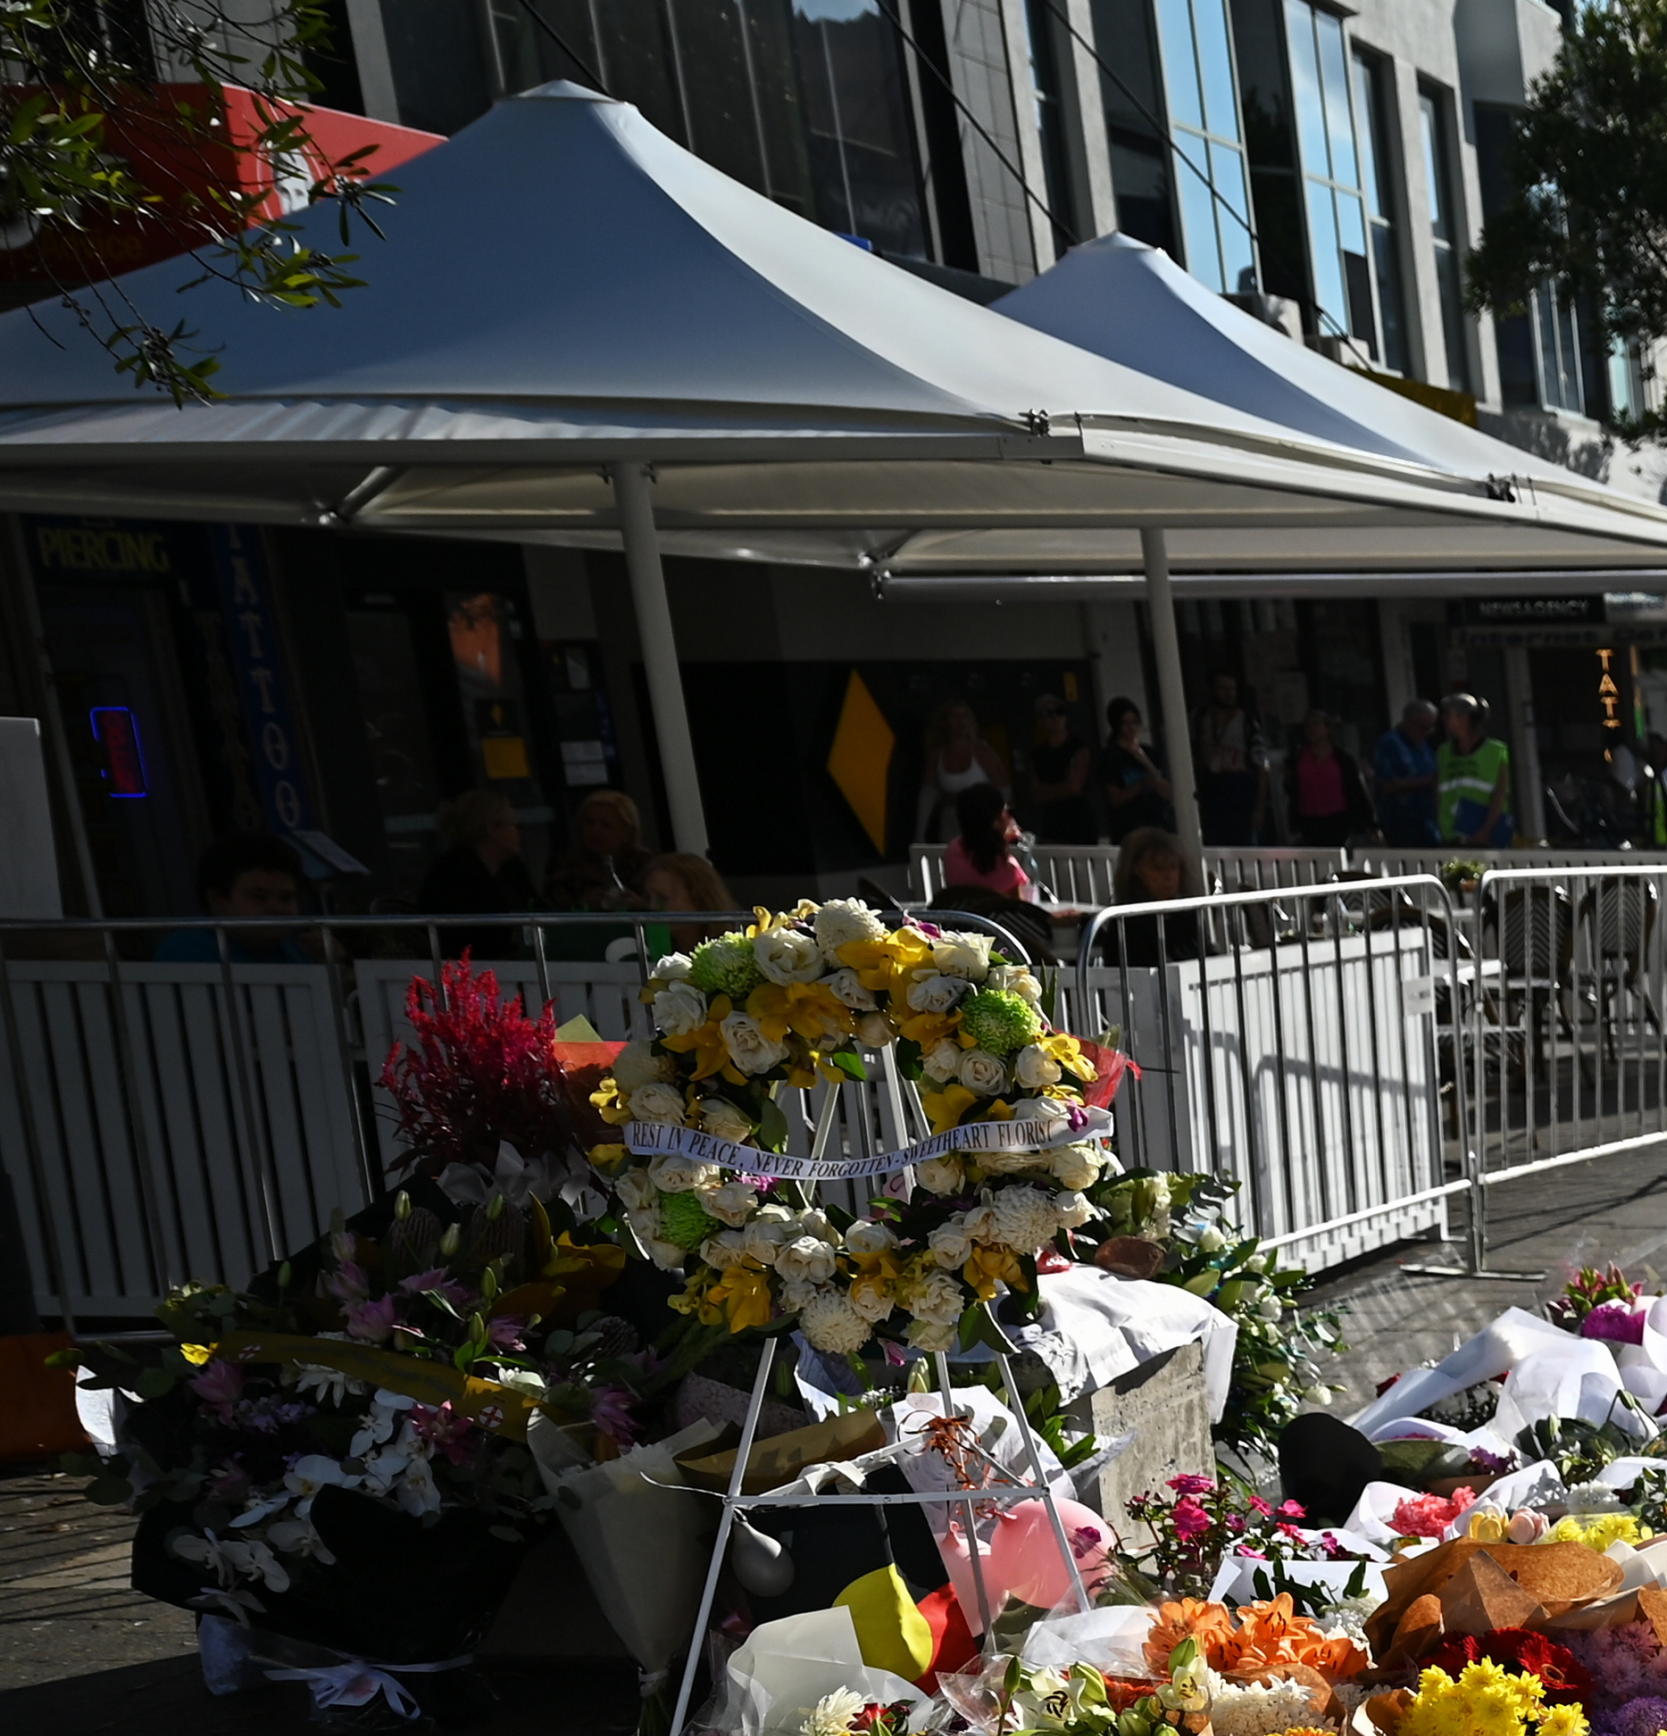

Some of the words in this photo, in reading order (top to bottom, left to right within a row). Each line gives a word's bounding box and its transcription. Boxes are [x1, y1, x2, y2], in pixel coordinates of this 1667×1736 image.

[35, 527, 171, 573] PIERCING
[1479, 600, 1589, 617] NEWSAGENCY
[633, 1122, 663, 1147] REST
[668, 1127, 686, 1150] IN
[750, 1152, 803, 1176] NEVER
